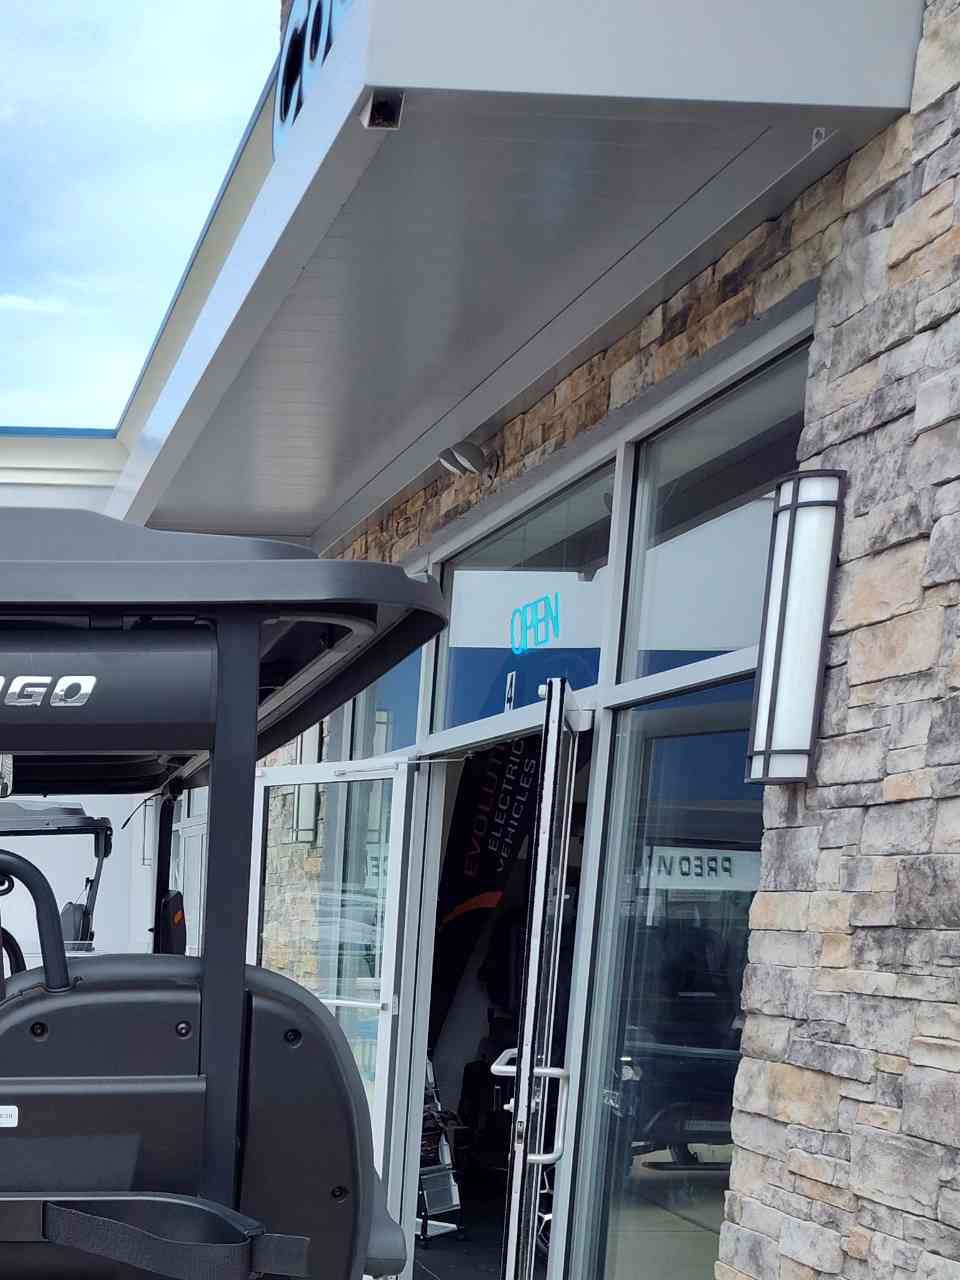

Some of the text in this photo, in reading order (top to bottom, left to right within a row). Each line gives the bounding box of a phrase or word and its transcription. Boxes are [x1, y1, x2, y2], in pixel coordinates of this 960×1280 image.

[511, 591, 560, 655] OPEN
[488, 739, 525, 852] ELECTRIC
[496, 759, 537, 873] VEHICLES
